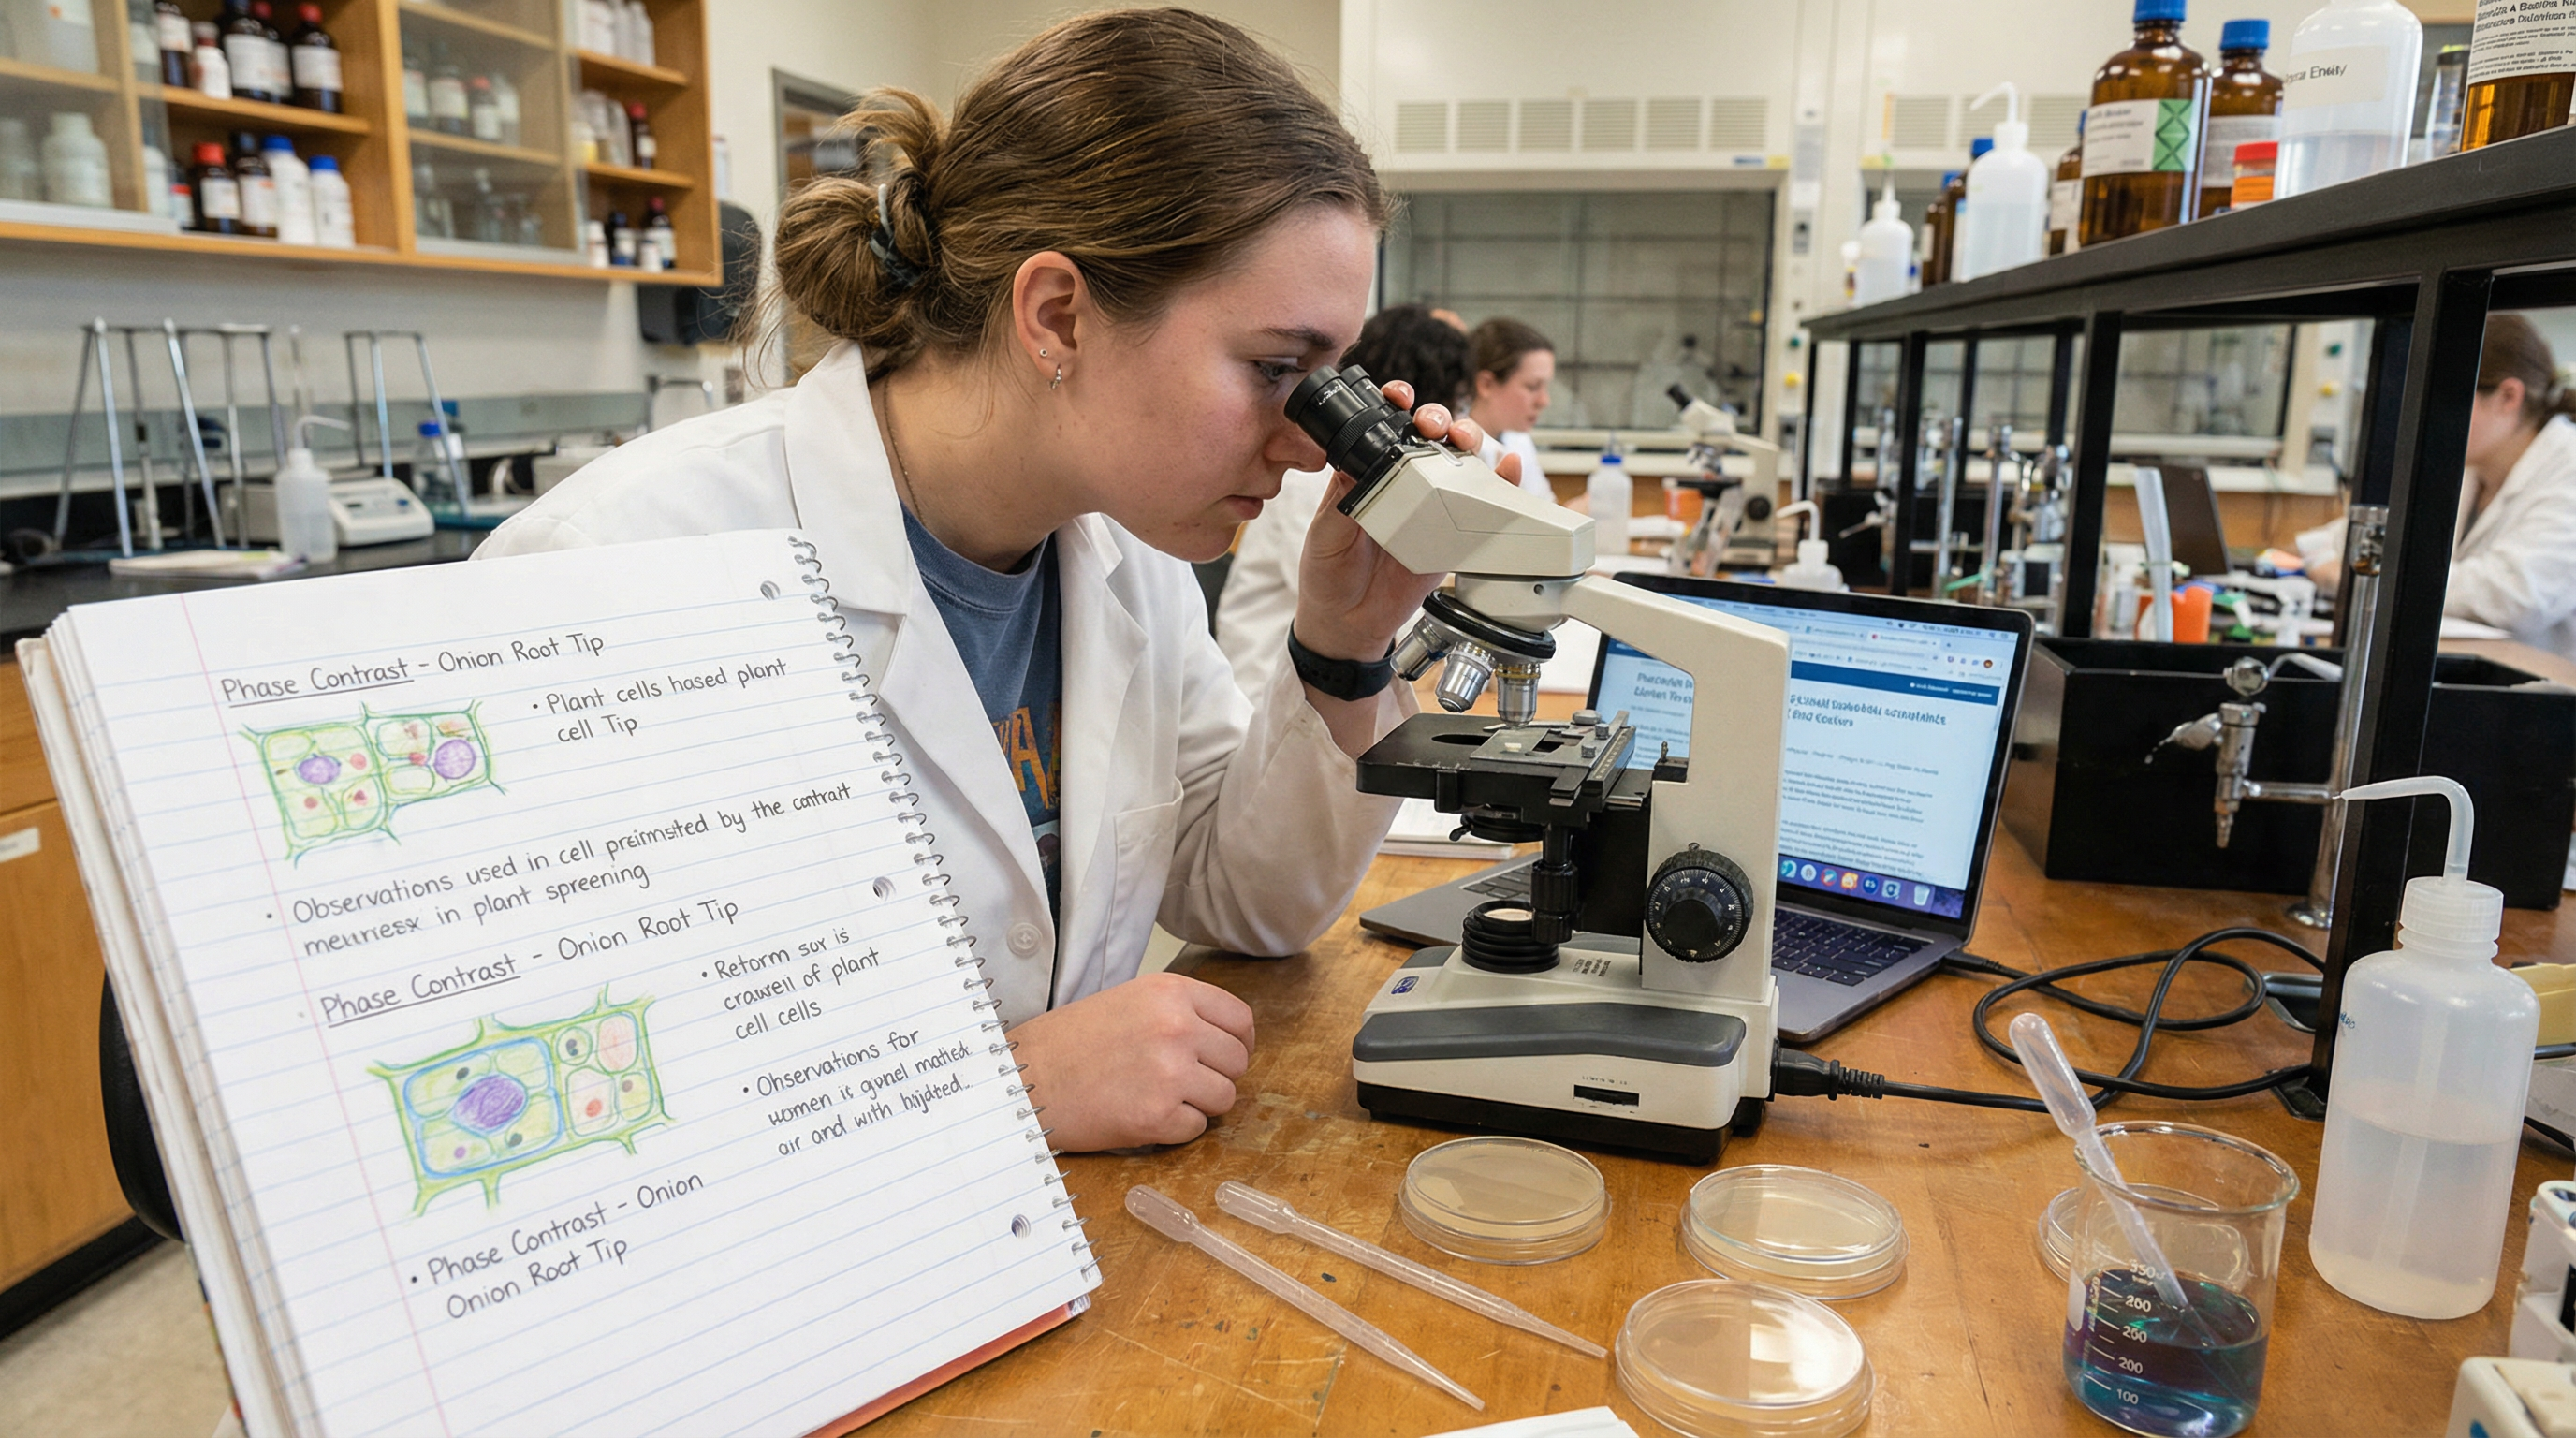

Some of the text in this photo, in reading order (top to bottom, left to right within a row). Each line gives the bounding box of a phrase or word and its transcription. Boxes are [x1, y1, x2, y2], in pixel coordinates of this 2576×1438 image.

[221, 678, 300, 702] Phase
[310, 657, 409, 691] Contrast
[438, 651, 504, 672] Onion
[511, 637, 560, 662] Root
[565, 633, 604, 657] Tip
[546, 687, 605, 714] Plant
[616, 680, 663, 703] cells
[737, 658, 787, 689] plant
[557, 714, 638, 742] cell Tip
[293, 873, 454, 924] Observations
[465, 855, 519, 886] used
[526, 852, 550, 872] in
[559, 839, 595, 865] cell
[717, 811, 747, 834] by
[750, 800, 785, 820] the
[435, 905, 461, 925] in
[473, 885, 532, 926] plant
[545, 864, 650, 904] spreening
[320, 989, 402, 1022] Phase
[411, 953, 517, 999] Contrast
[558, 932, 628, 961] Onion
[638, 907, 691, 939] Root
[697, 899, 739, 925] Tip
[832, 927, 850, 945] is
[803, 963, 822, 988] of
[831, 946, 879, 986] plant
[735, 1000, 822, 1040] cell cells
[887, 1029, 920, 1051] for
[778, 1135, 802, 1156] air
[812, 1114, 848, 1146] and
[854, 1101, 893, 1129] with
[427, 1246, 504, 1285] Phase
[511, 1200, 608, 1255] Contrast
[637, 1174, 704, 1209] Onion
[446, 1238, 628, 1319] Onion Root Tip
[2118, 1357, 2144, 1374] 200
[2117, 1388, 2139, 1405] 100
